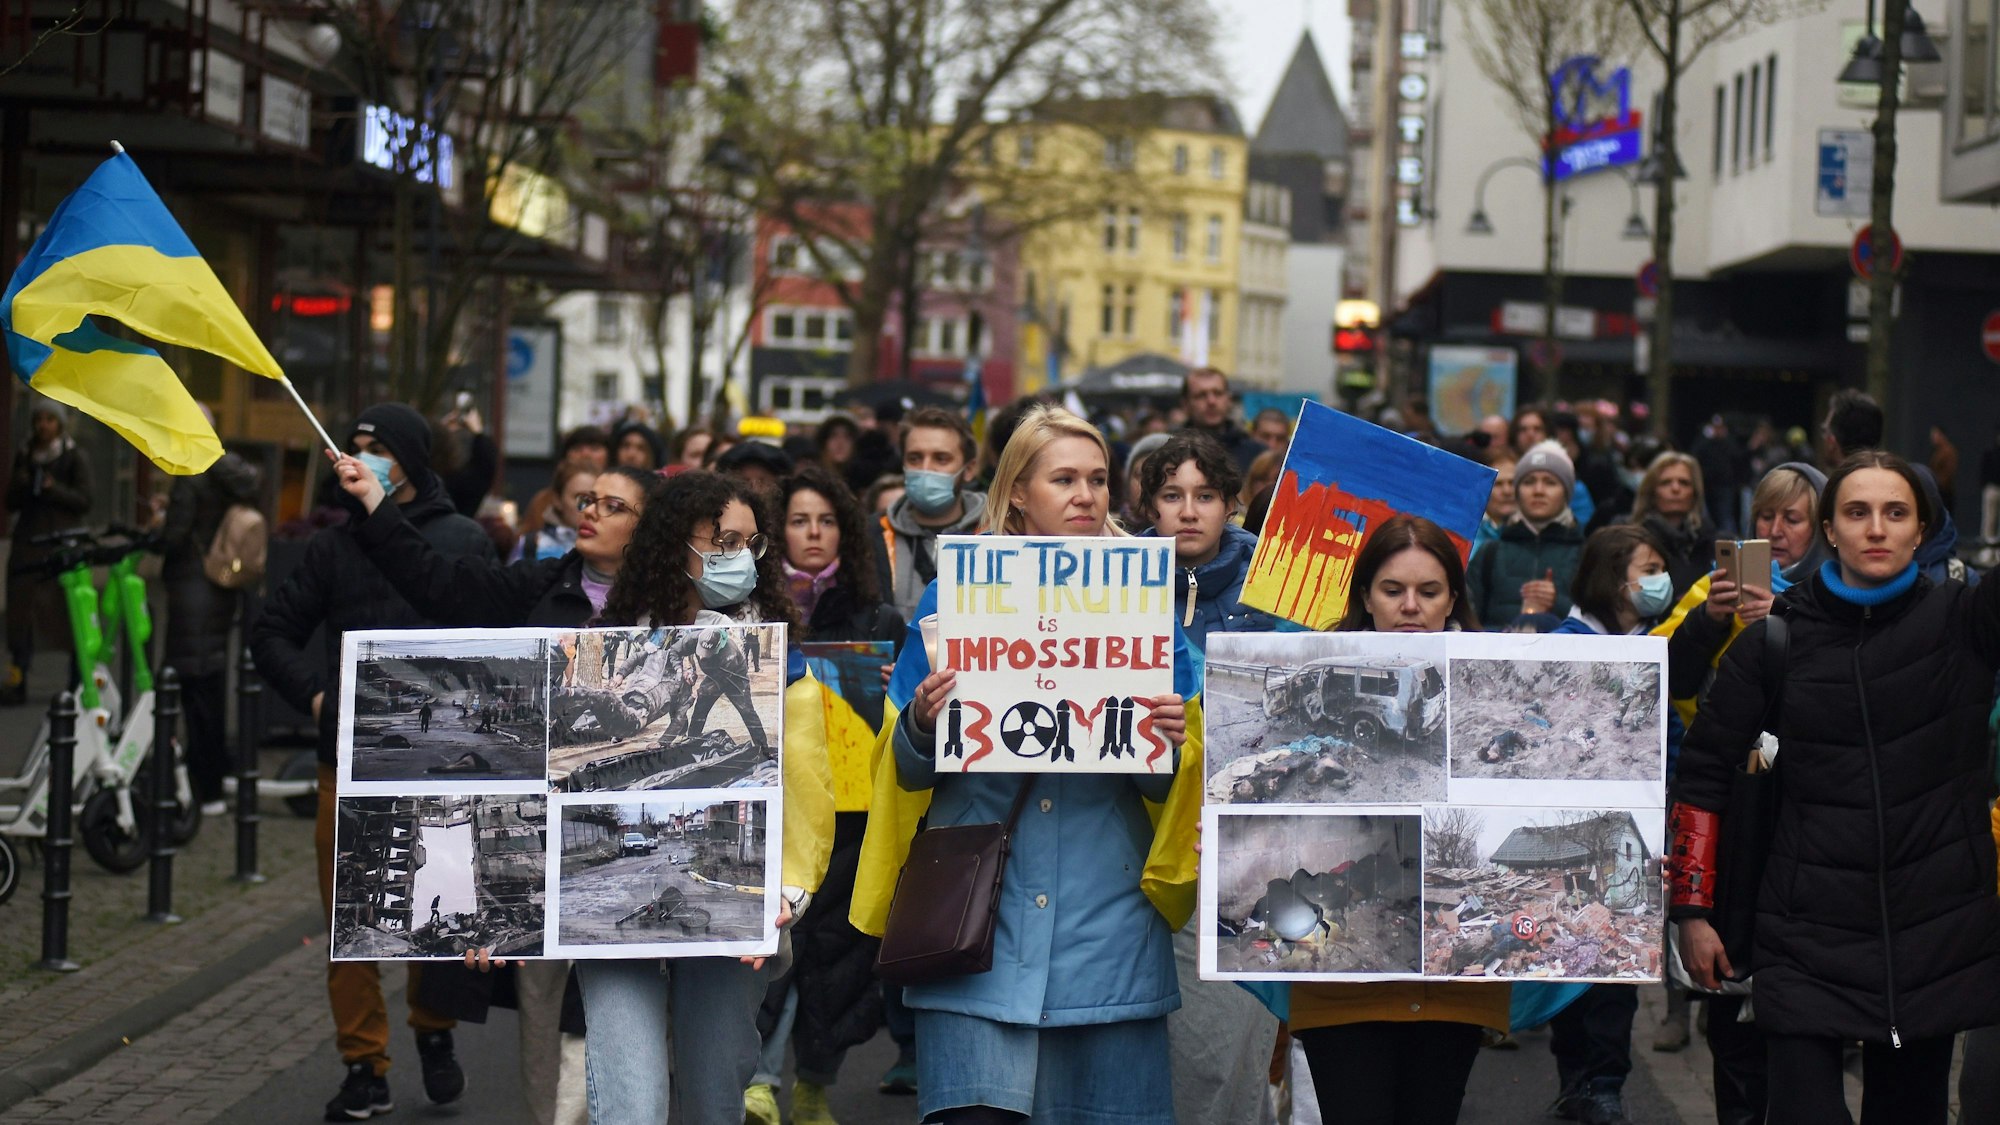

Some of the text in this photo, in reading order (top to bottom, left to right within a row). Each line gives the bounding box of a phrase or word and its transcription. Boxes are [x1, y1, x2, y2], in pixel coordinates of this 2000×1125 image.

[1398, 32, 1426, 226] HOTEL
[942, 541, 1170, 614] THE TRUTH
[1037, 615, 1058, 632] is
[945, 635, 1170, 672] IMPOSSIBLE
[1034, 673, 1057, 690] to
